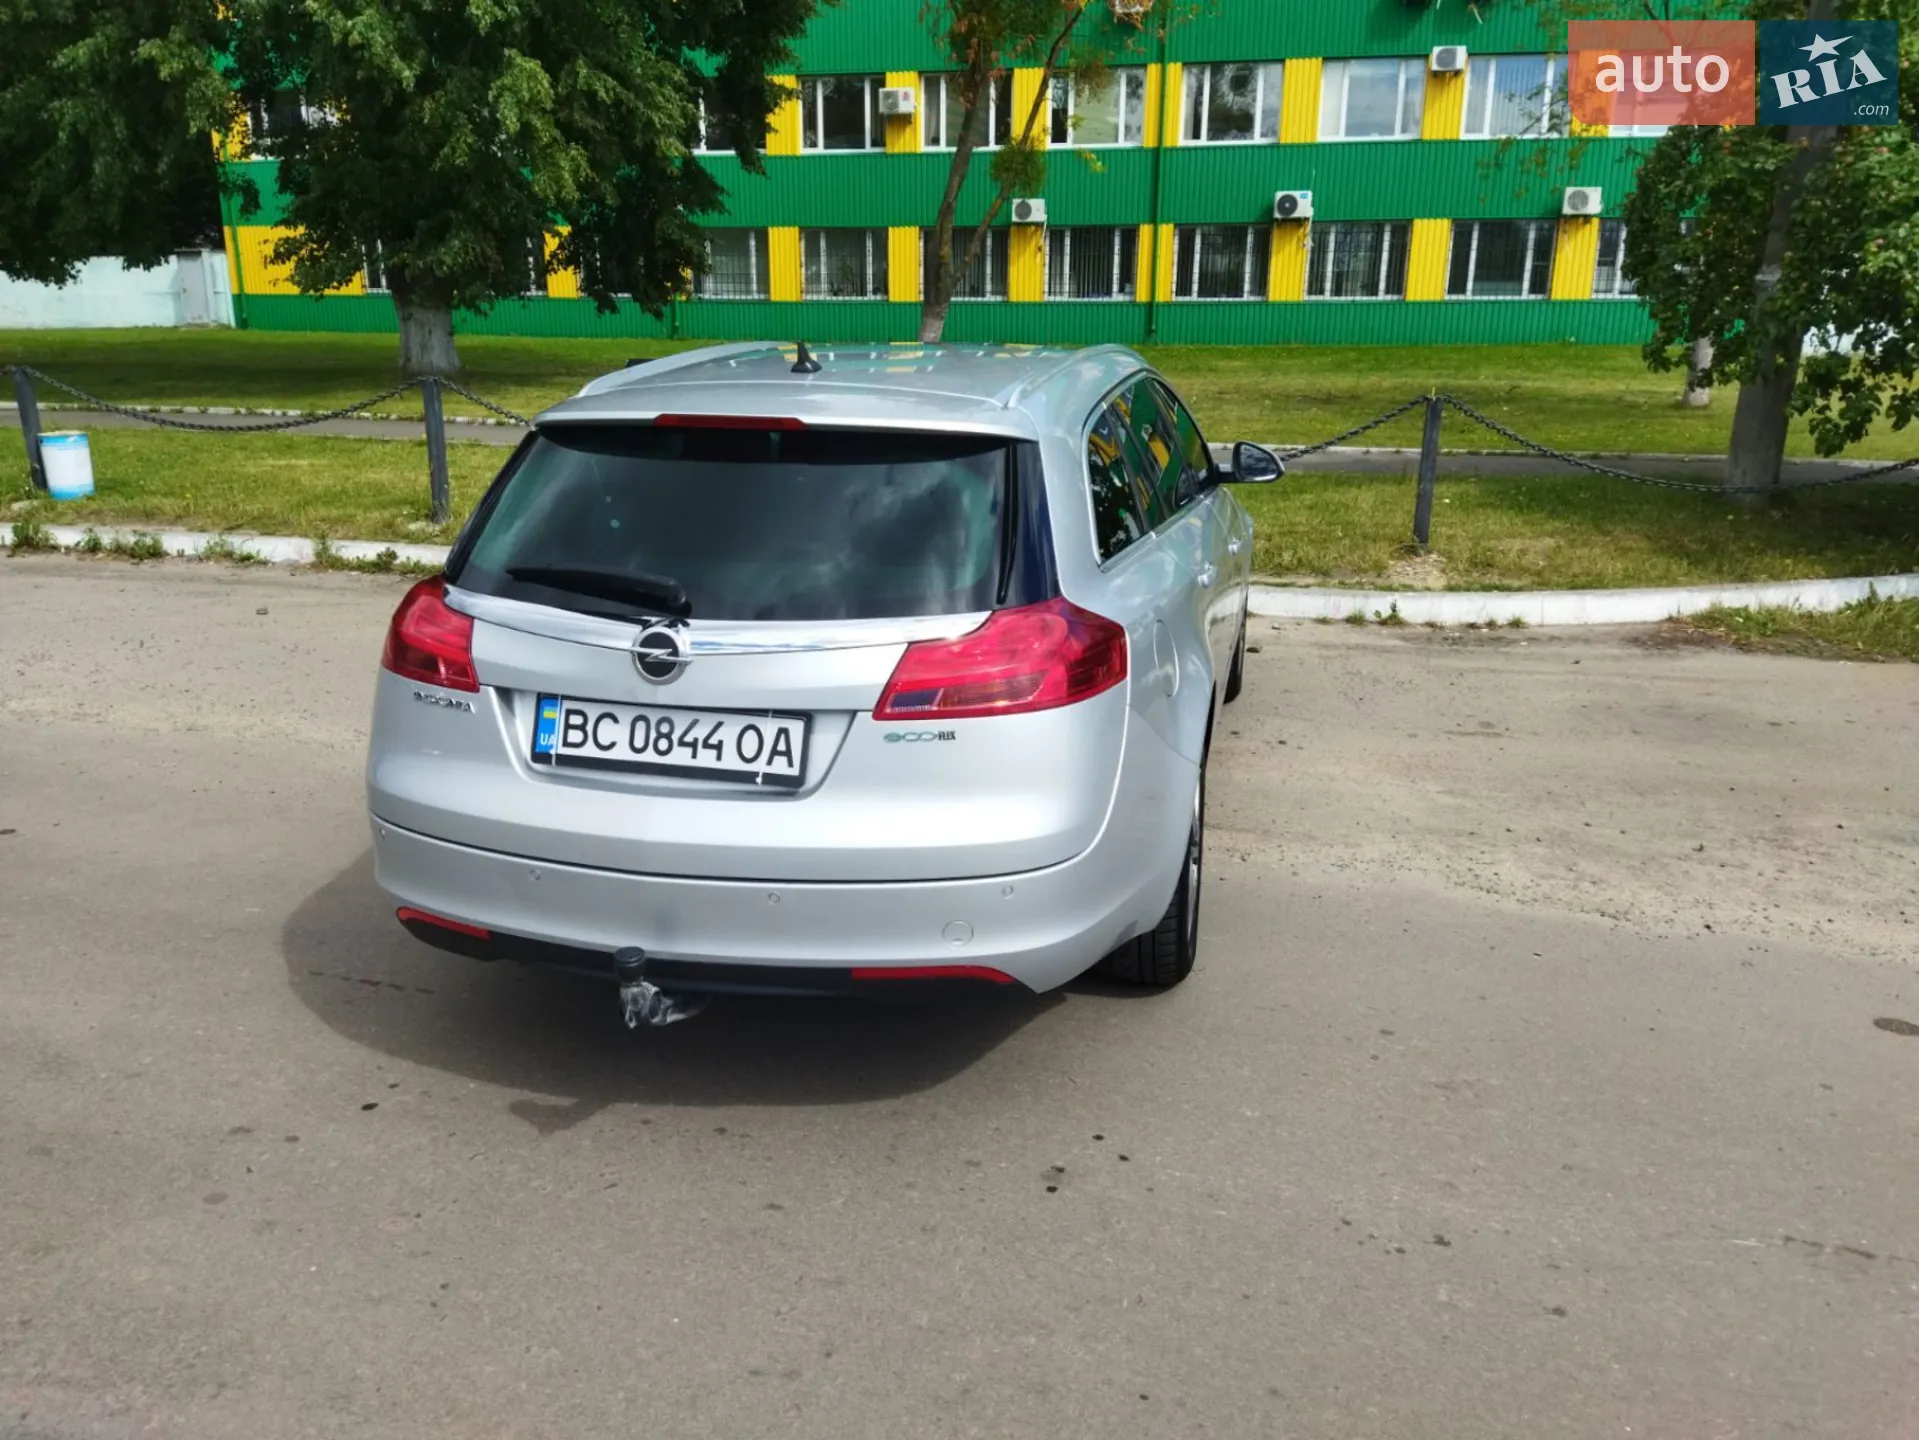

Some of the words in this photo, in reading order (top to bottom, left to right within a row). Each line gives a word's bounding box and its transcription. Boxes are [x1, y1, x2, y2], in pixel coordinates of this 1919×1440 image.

[562, 709, 619, 751] BC
[628, 714, 725, 762] 0844
[736, 723, 795, 768] OA
